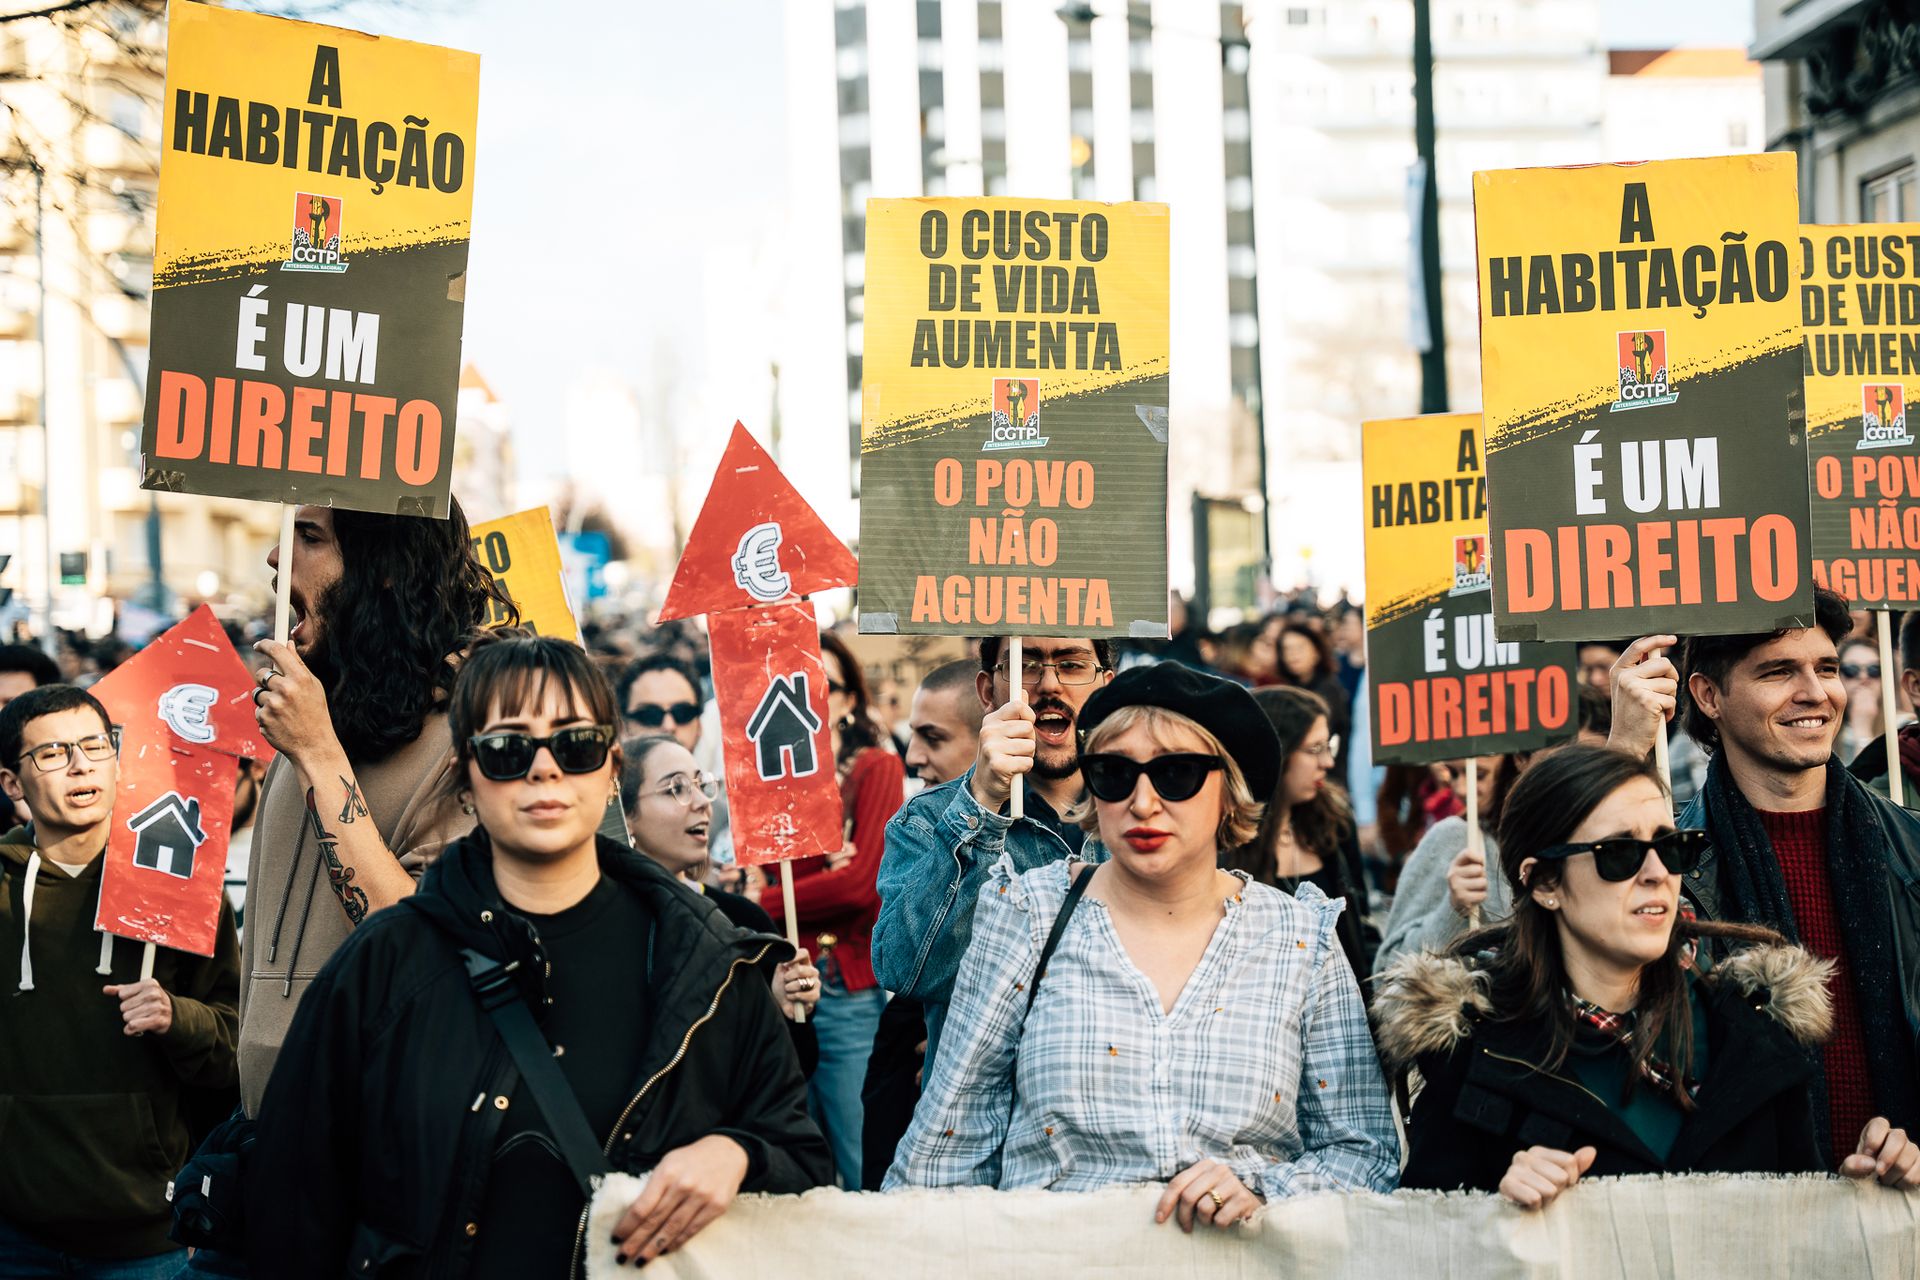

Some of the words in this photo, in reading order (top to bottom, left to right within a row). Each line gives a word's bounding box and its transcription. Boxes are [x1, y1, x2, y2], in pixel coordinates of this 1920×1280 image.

[308, 45, 342, 108] A
[173, 90, 466, 195] HABITAÇÃO
[920, 210, 948, 259] O
[961, 210, 1109, 263] CUSTO
[1620, 183, 1655, 243] A
[294, 246, 337, 264] CGTP
[1489, 231, 1789, 319] HABITAÇÃO
[1826, 235, 1920, 280] CUST
[928, 264, 981, 312] DE
[993, 265, 1101, 314] VIDA
[1801, 284, 1848, 327] DE
[1856, 283, 1920, 326] VID
[235, 284, 269, 372] É
[284, 302, 380, 385] UM
[910, 319, 1122, 371] AUMENTA
[1622, 383, 1667, 400] CGTP
[155, 370, 443, 486] DIREITO
[994, 426, 1037, 441] CGTP
[1457, 429, 1479, 472] A
[1866, 426, 1905, 440] CGTP
[934, 458, 962, 505] O
[976, 459, 1094, 508] POVO
[1572, 430, 1607, 516] É
[1620, 437, 1721, 514] UM
[1816, 456, 1843, 499] O
[1852, 455, 1920, 499] POV
[1373, 476, 1488, 528] HABITA
[1849, 498, 1920, 550] NÃO
[969, 508, 1058, 566] NÃO
[1504, 514, 1799, 613] DIREITO
[911, 575, 1113, 627] AGUENTA
[1423, 608, 1447, 673] É
[1454, 612, 1520, 670] UM
[1378, 665, 1570, 746] DIREITO
